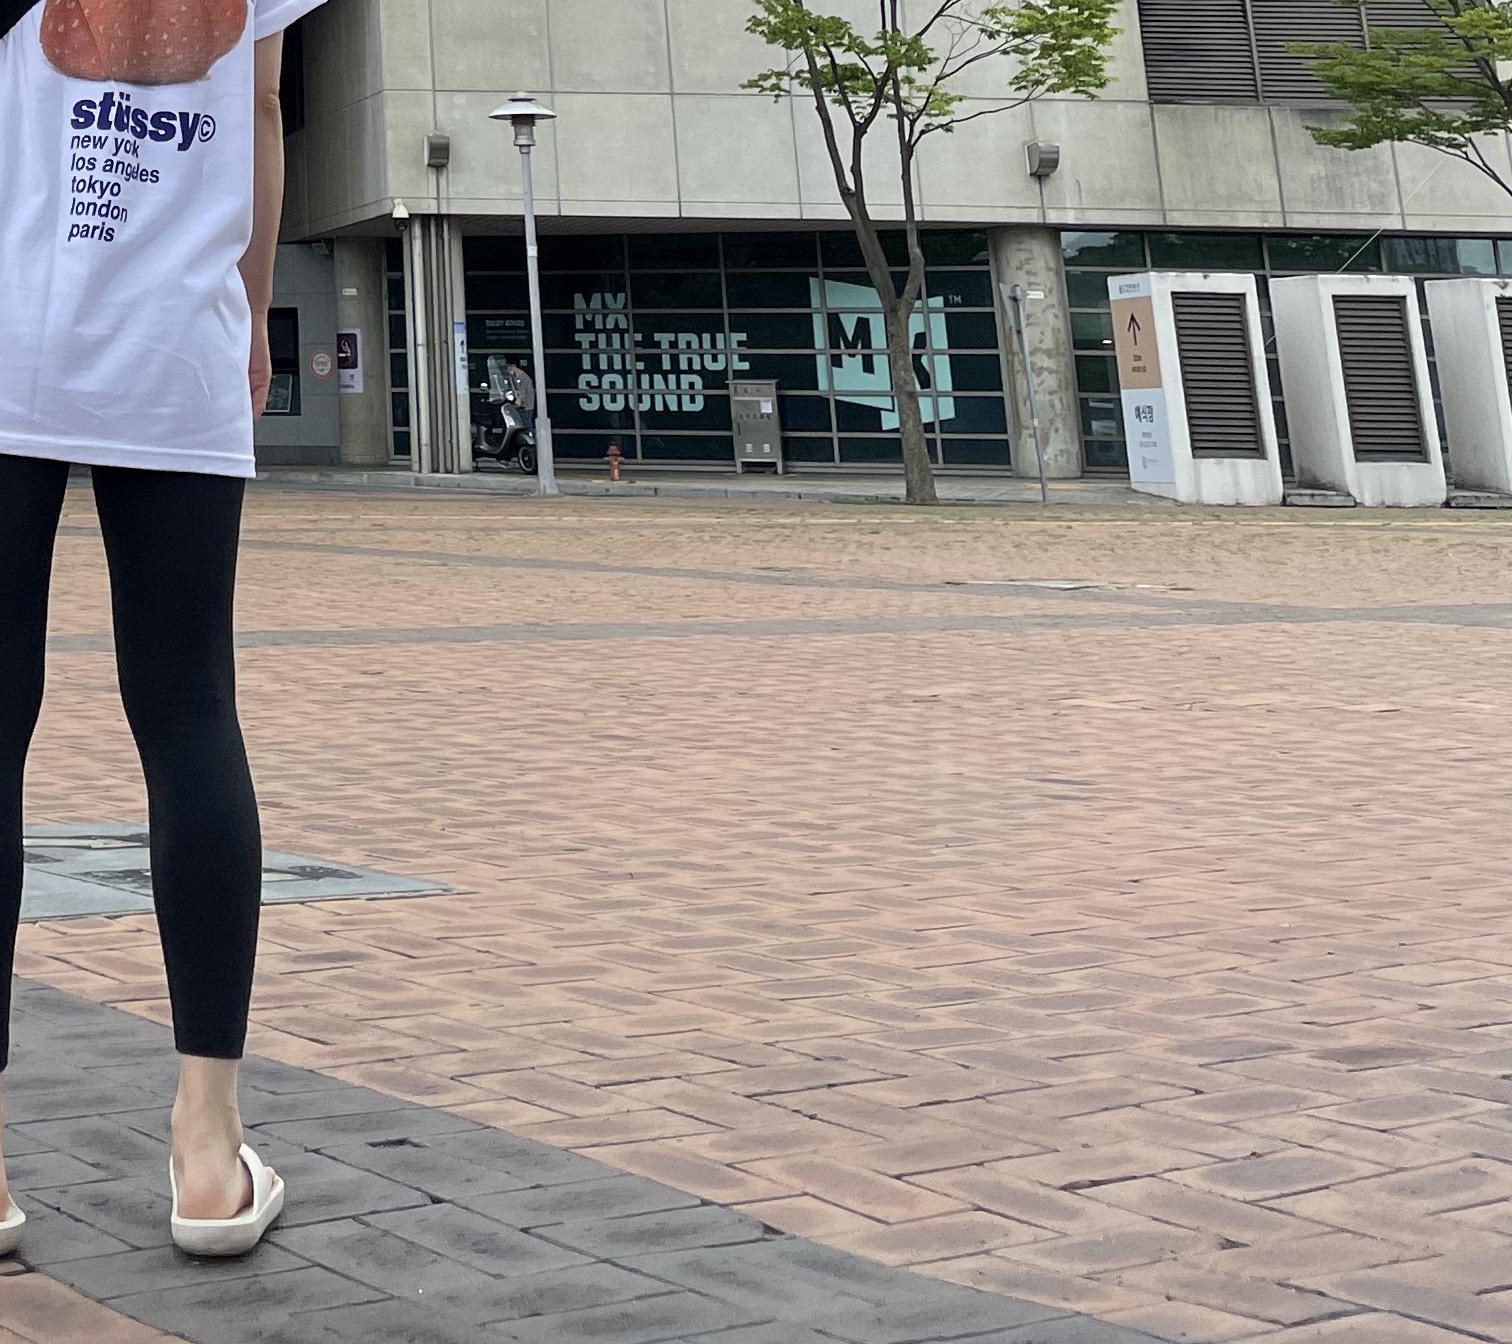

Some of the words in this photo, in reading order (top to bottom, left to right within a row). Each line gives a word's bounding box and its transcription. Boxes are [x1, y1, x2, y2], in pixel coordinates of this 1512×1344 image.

[70, 134, 109, 150] new
[70, 152, 97, 172] los
[71, 174, 122, 200] tokyo
[69, 196, 128, 223] london
[67, 221, 115, 243] paris
[574, 292, 629, 330] MX
[574, 332, 645, 371] THE
[653, 332, 750, 371] TRUE
[577, 373, 705, 412] SOUND
